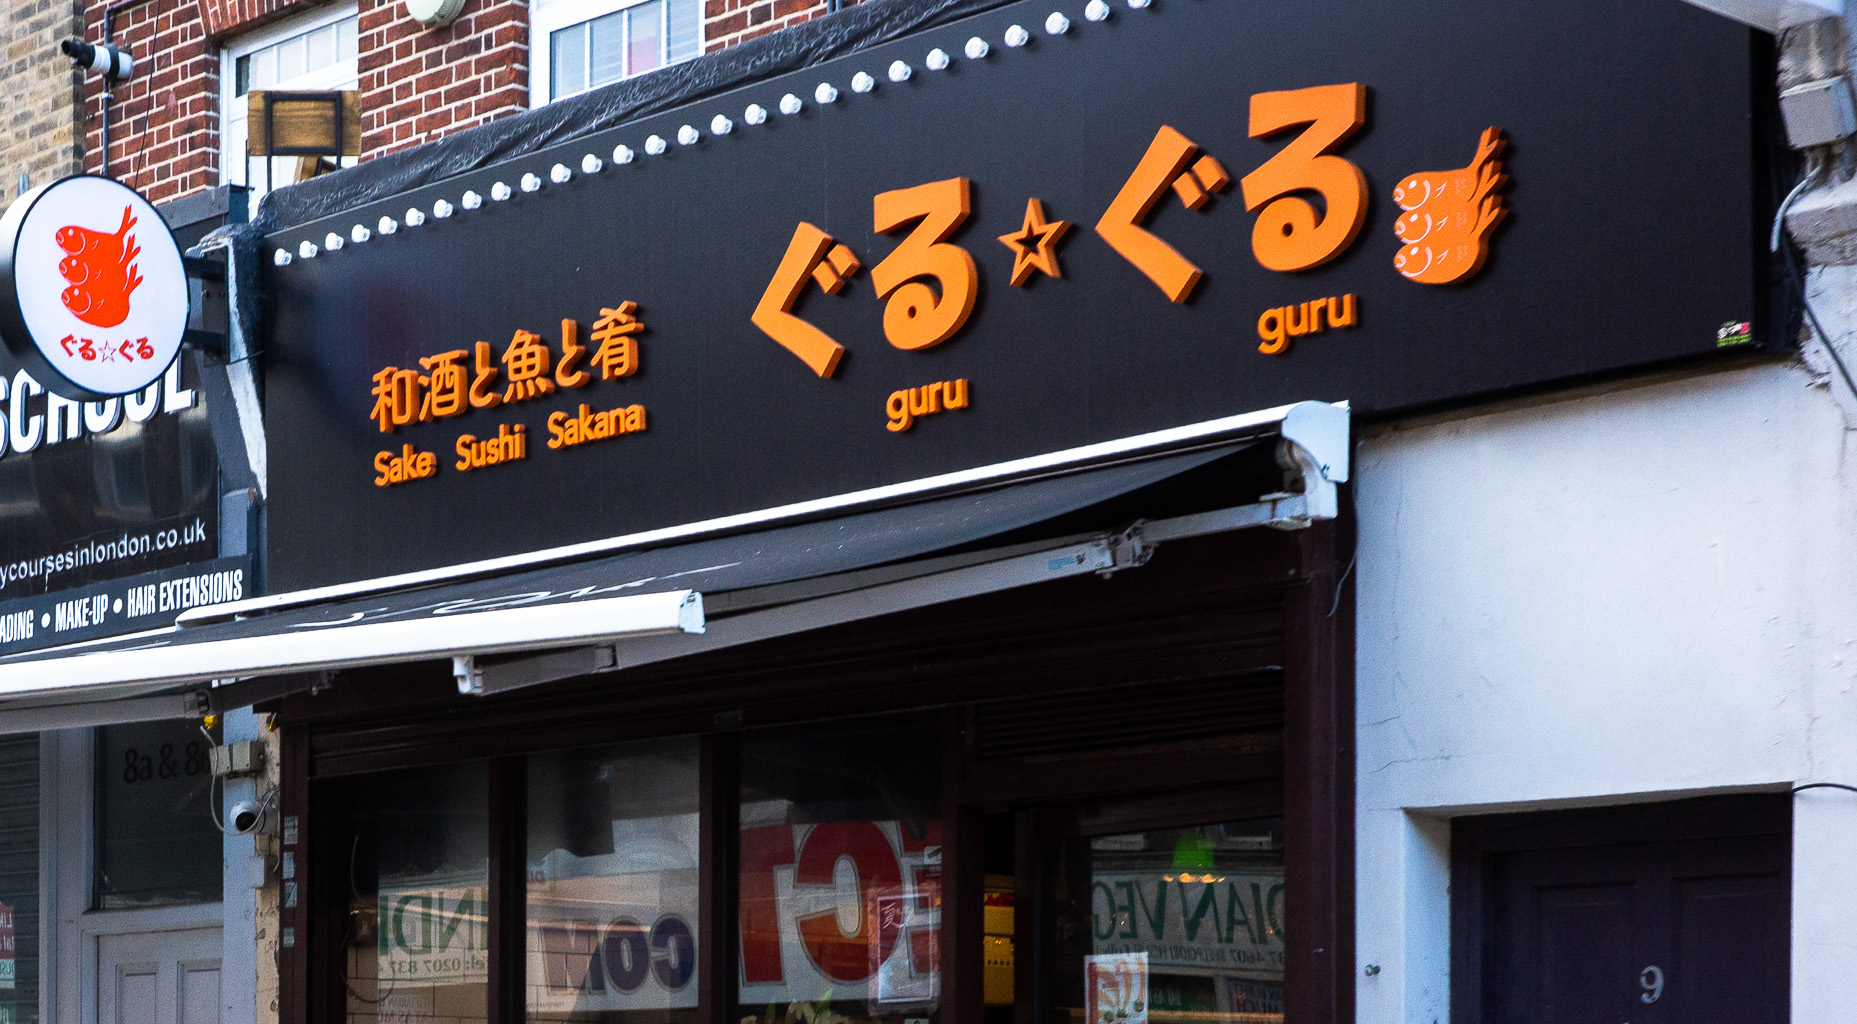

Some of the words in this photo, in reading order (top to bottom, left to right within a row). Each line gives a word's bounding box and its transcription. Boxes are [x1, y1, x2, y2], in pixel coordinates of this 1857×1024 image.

[1257, 293, 1357, 354] guru
[370, 300, 645, 433] 和酒と魚と肴
[886, 378, 969, 432] guru
[374, 443, 437, 487] Sake
[455, 423, 526, 471] Sushi
[547, 403, 647, 449] Sakana
[55, 594, 109, 632] MAKE-UP
[127, 583, 156, 618] HAIR
[159, 569, 243, 613] EXTENSIONS
[123, 748, 153, 784] 8a
[158, 742, 177, 778] &
[1640, 965, 1664, 1004] 9
